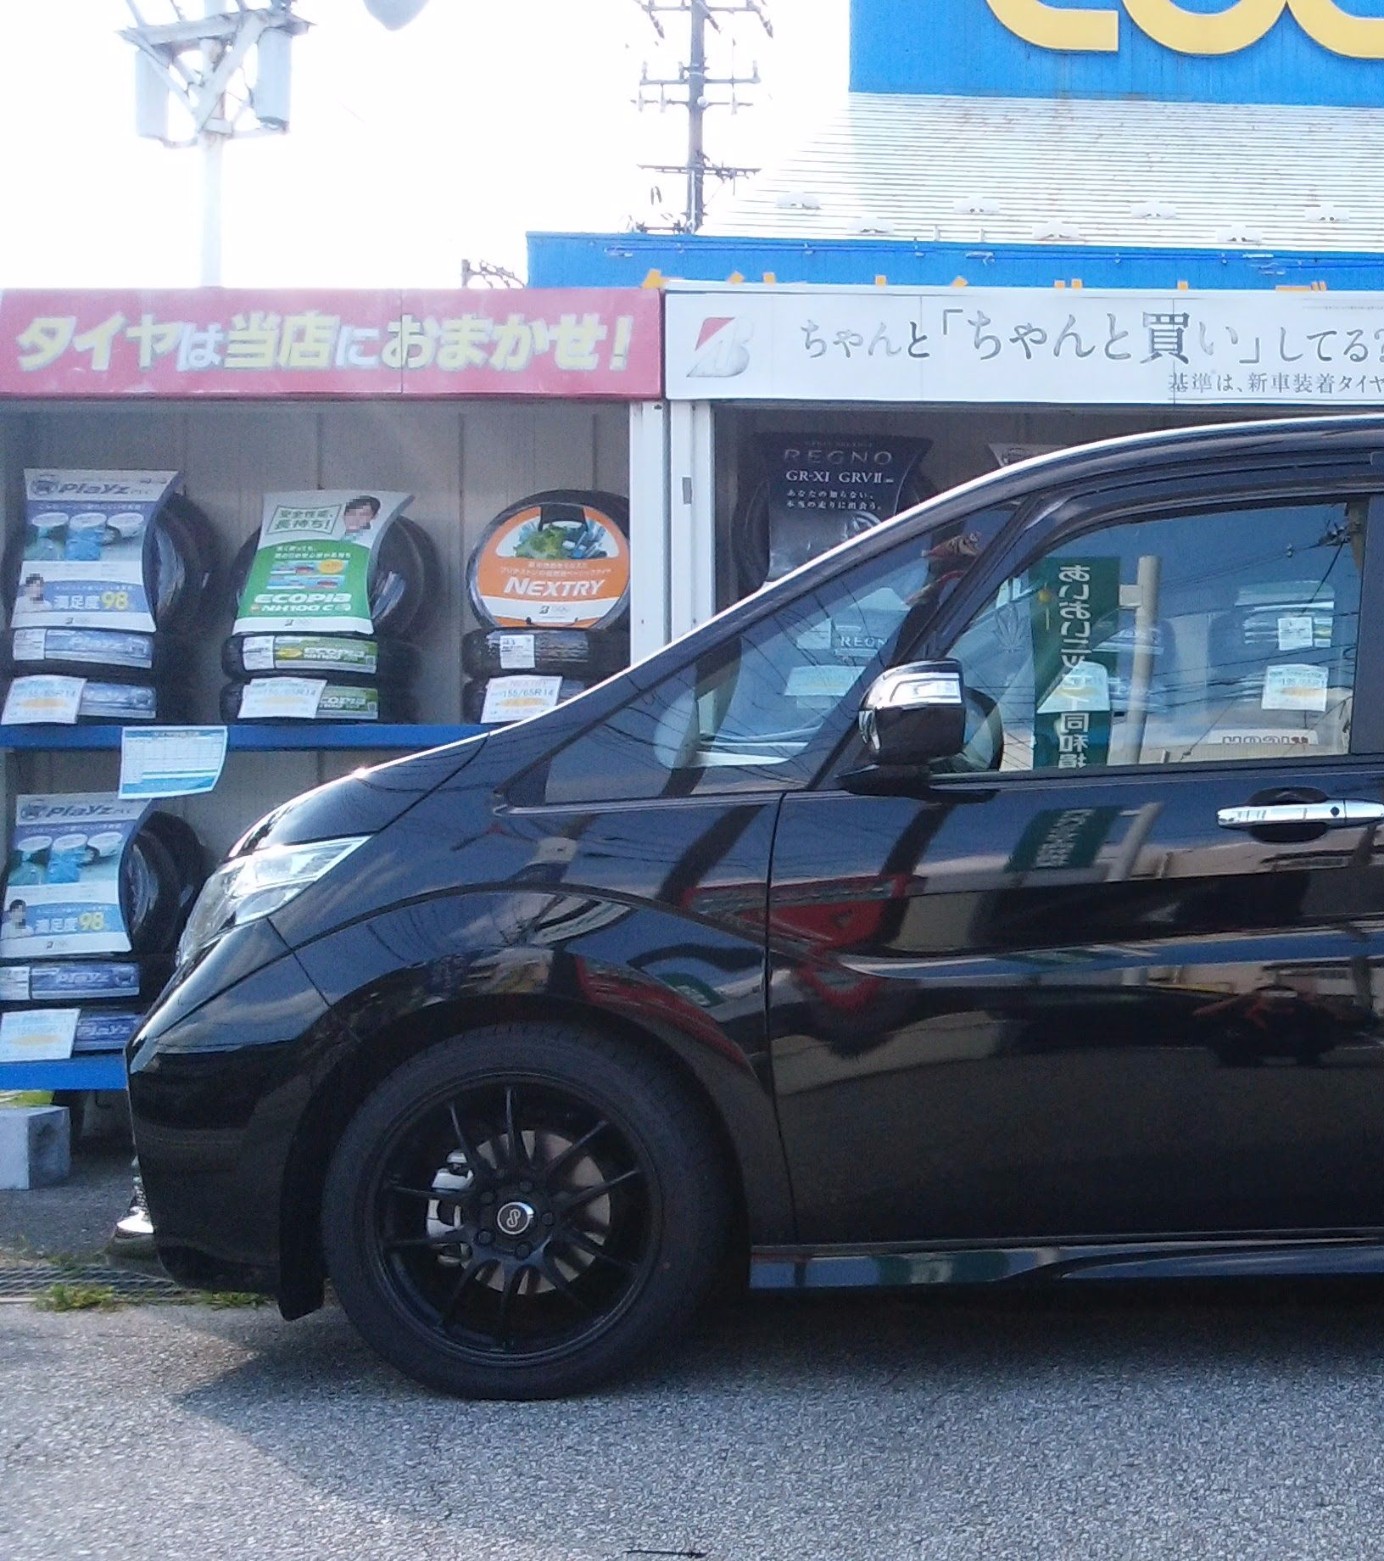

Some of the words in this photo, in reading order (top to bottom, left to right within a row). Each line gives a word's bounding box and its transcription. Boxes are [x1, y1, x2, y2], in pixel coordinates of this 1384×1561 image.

[16, 312, 634, 373] タイヤは当店におまかせ!
[783, 448, 893, 465] REGNO
[503, 577, 607, 597] NEXTRY
